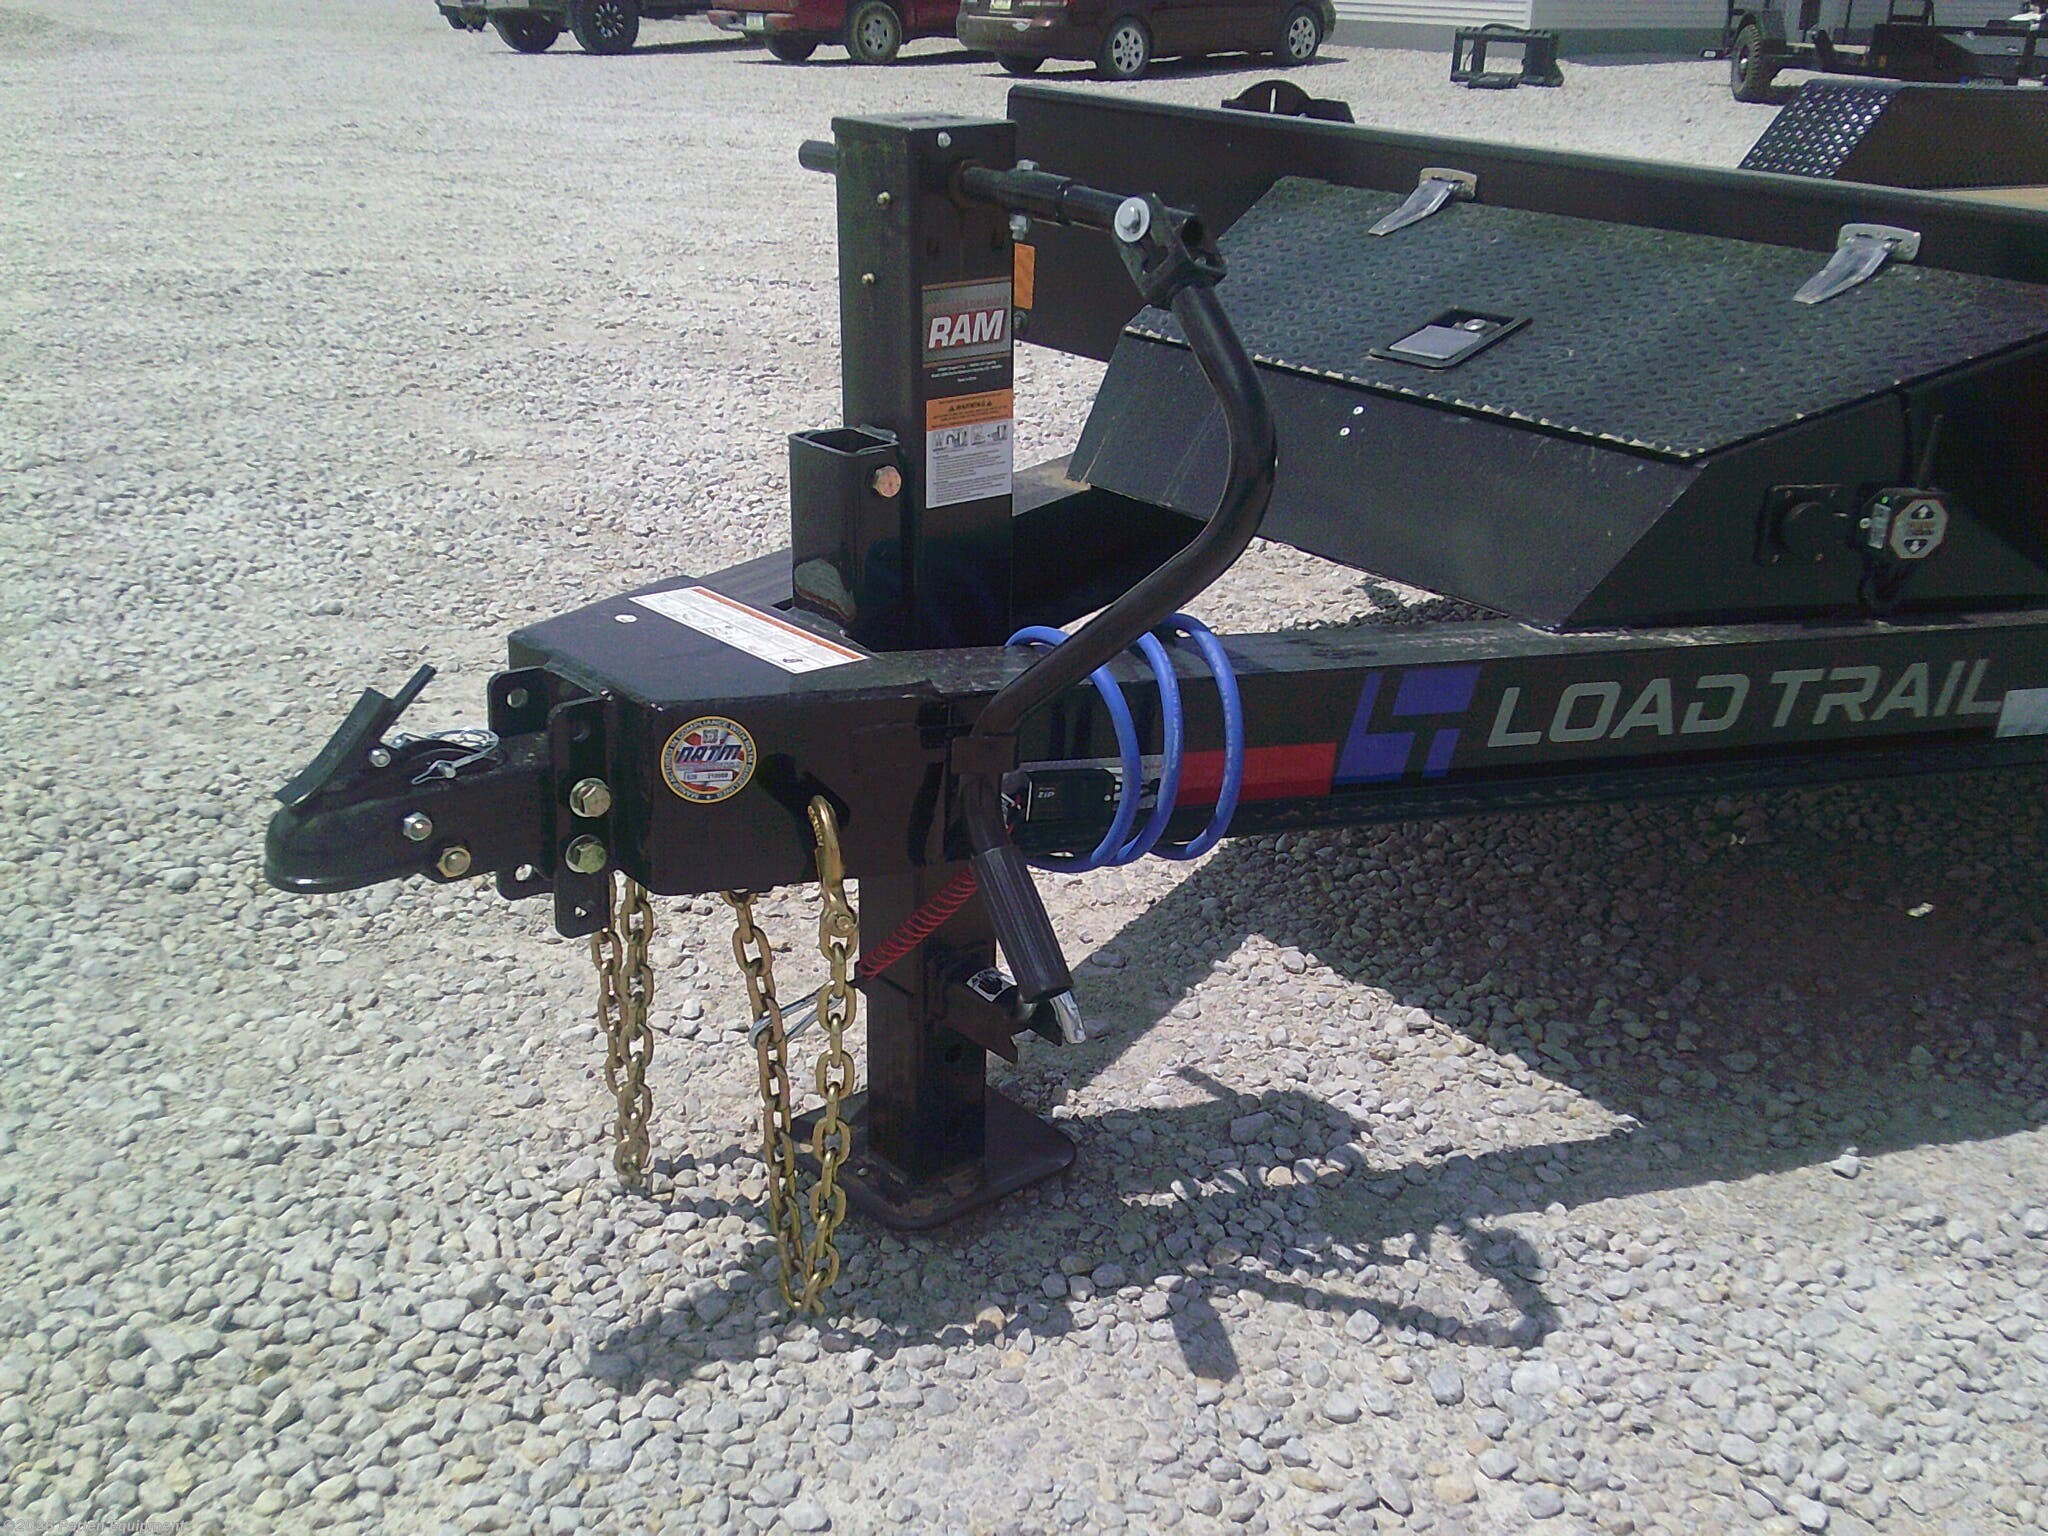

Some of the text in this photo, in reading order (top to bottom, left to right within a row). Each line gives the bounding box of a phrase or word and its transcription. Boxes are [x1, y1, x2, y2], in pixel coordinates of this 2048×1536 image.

[928, 309, 1005, 349] RAM
[1487, 657, 2002, 748] LOAD TRAIL
[676, 744, 742, 763] NATM
